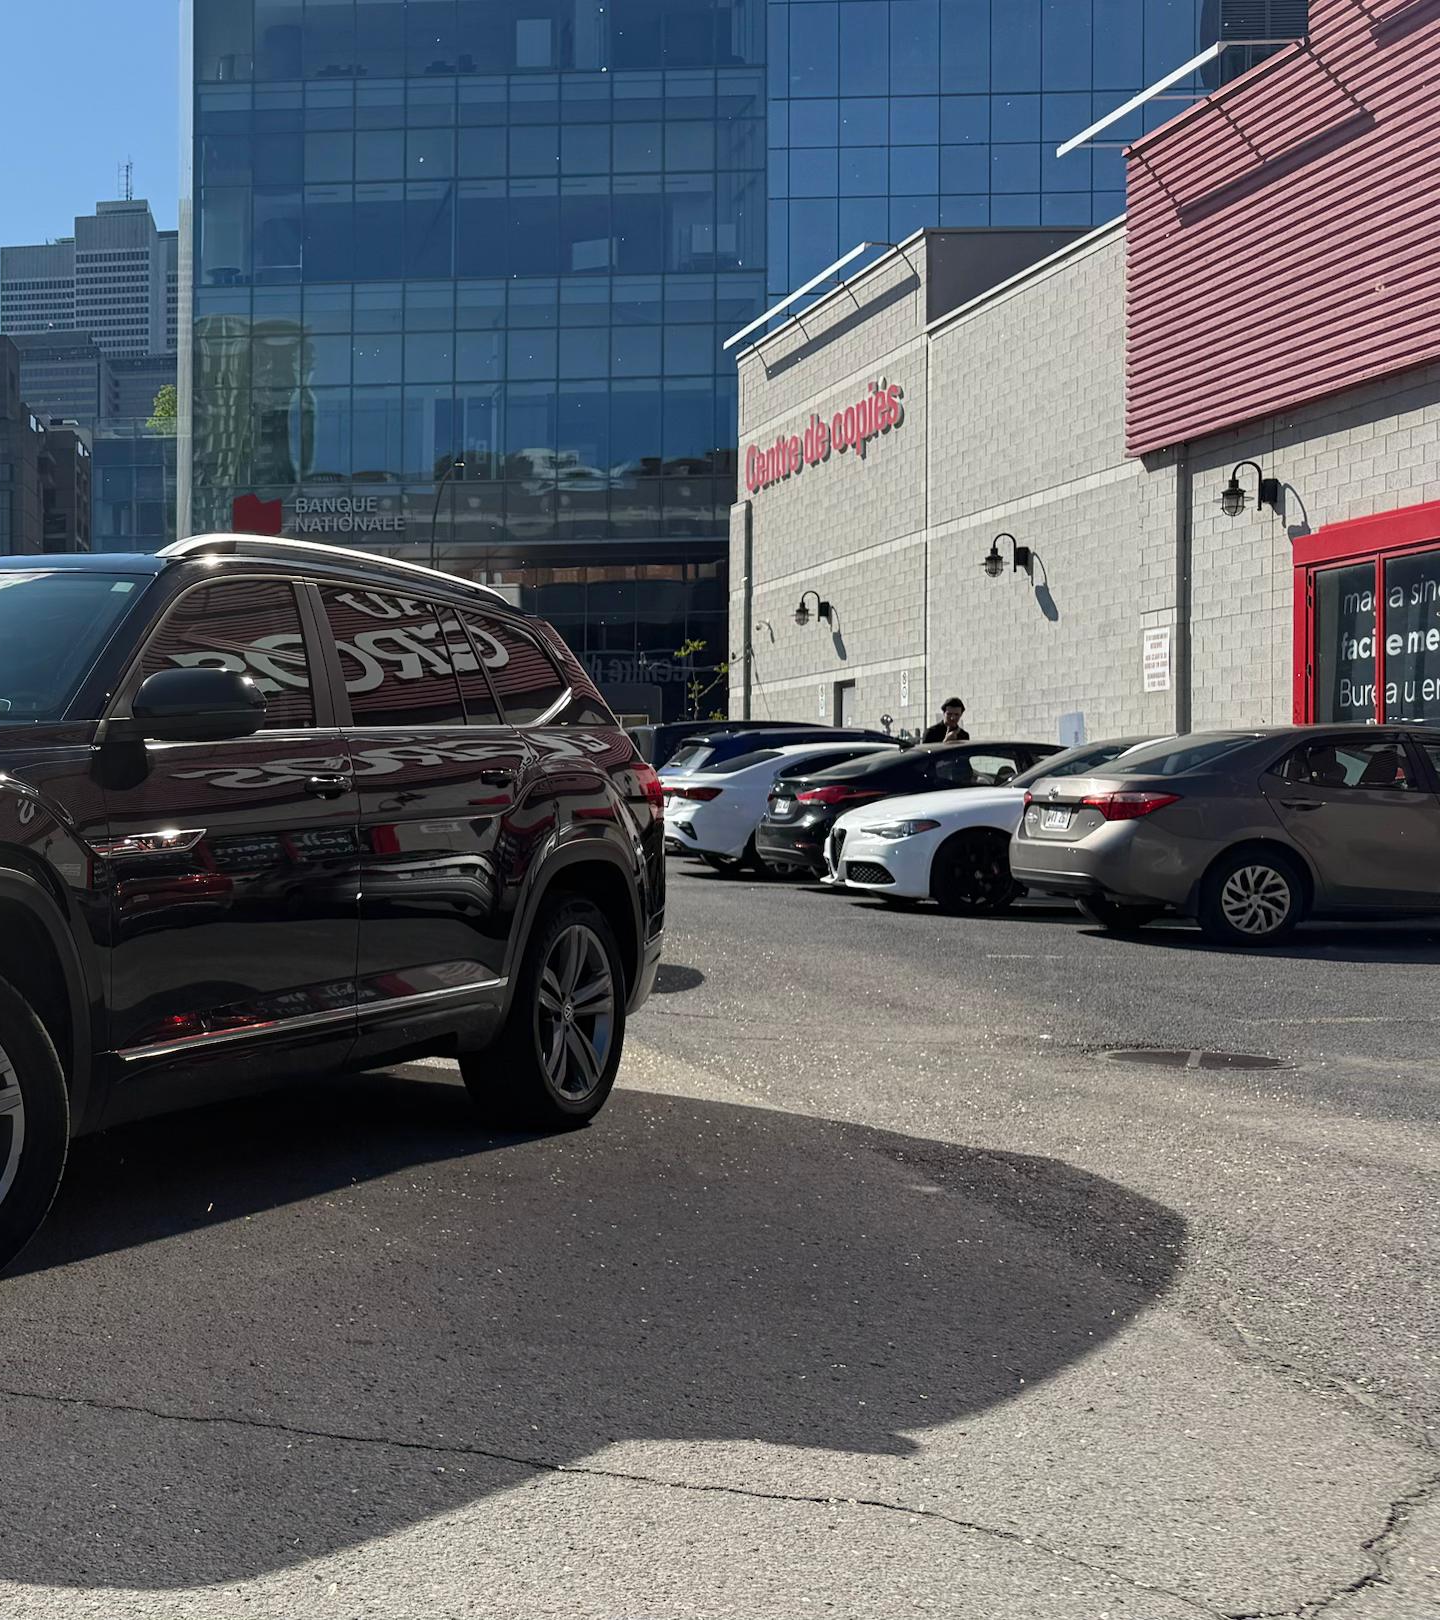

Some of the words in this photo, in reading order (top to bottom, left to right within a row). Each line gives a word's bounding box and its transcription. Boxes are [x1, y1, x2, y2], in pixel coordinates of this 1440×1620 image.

[746, 433, 803, 493] Centre
[804, 413, 830, 466] de
[832, 379, 903, 458] copies
[295, 496, 378, 514] BANQUE
[295, 515, 407, 533] NATIONALE
